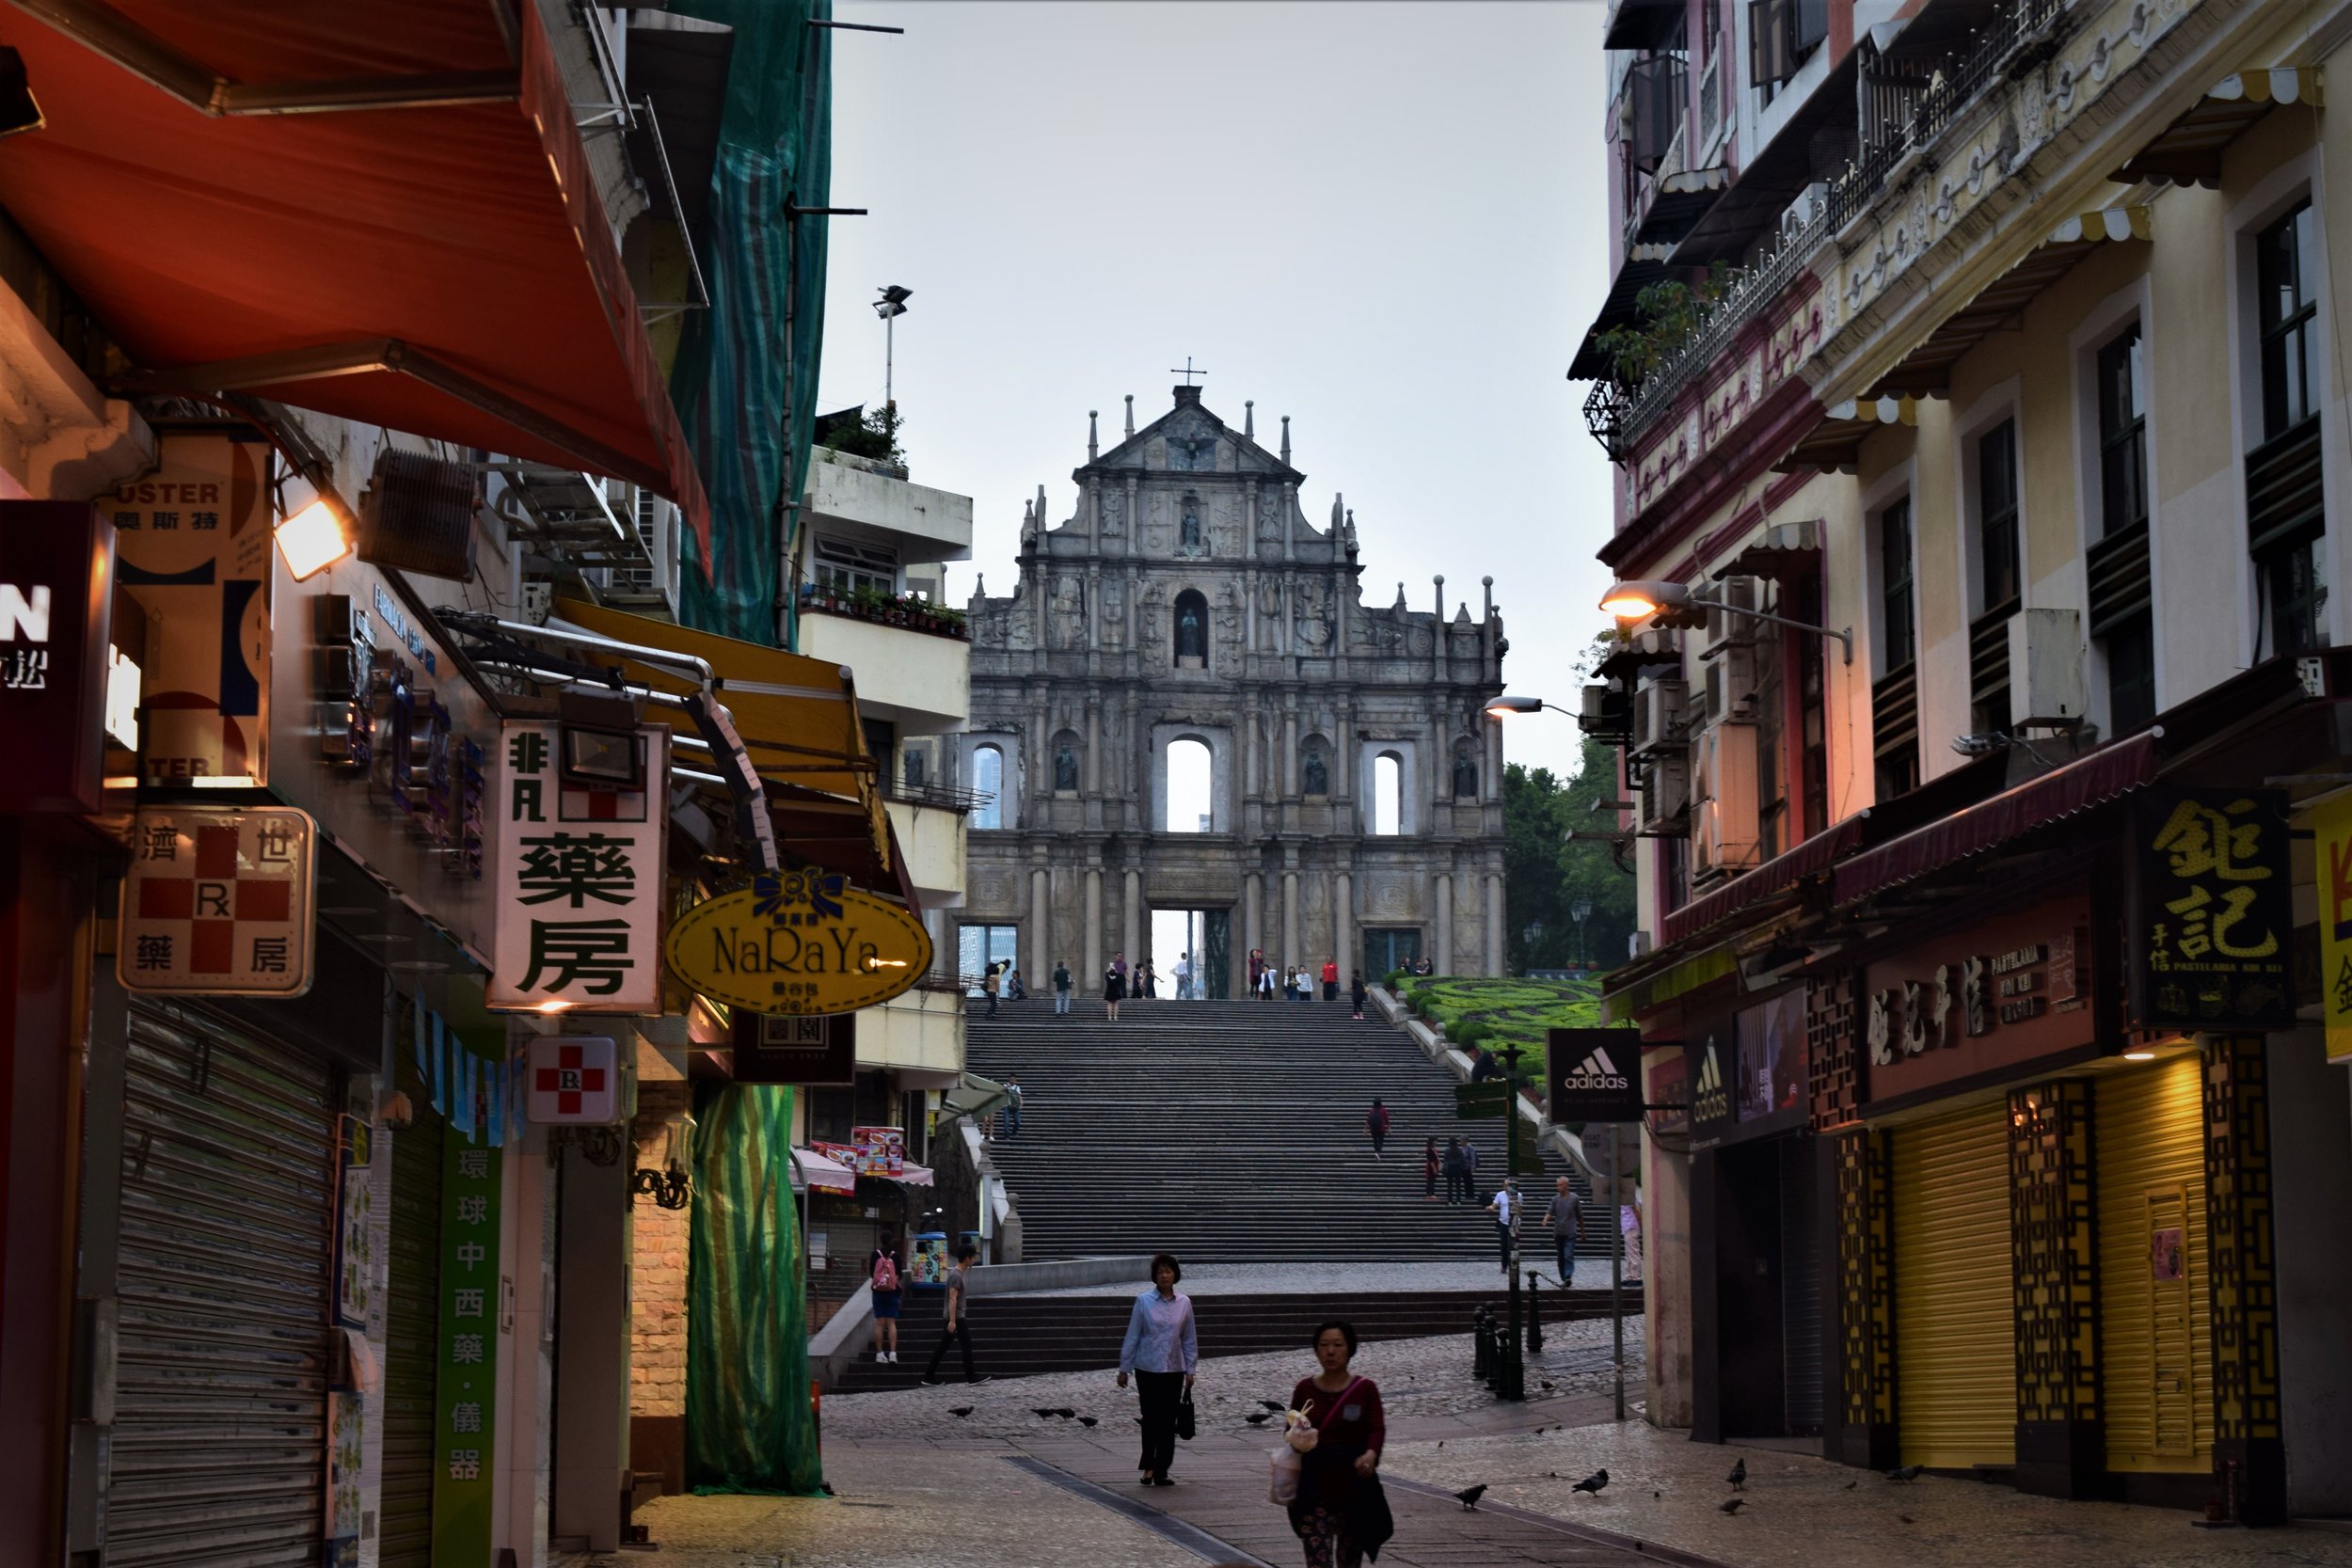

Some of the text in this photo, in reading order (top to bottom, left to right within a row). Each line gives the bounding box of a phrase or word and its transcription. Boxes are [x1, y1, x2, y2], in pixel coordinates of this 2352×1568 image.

[712, 927, 880, 974] NaRaYa
[1565, 1073, 1629, 1089] adidas
[1693, 1088, 1727, 1123] adidas
